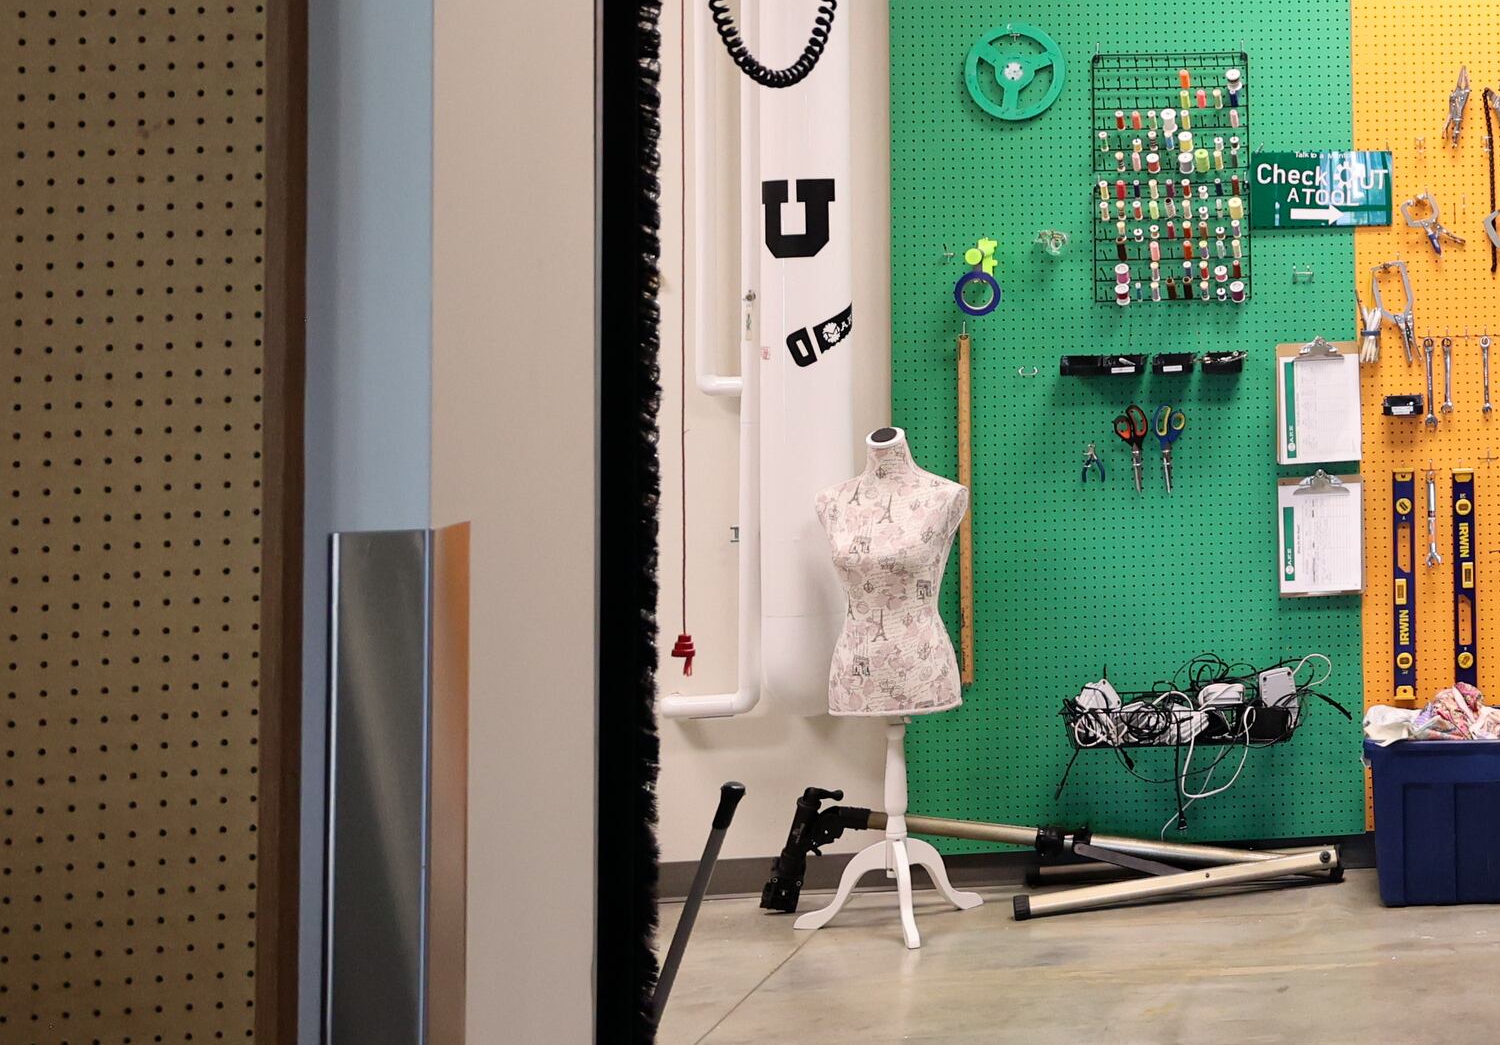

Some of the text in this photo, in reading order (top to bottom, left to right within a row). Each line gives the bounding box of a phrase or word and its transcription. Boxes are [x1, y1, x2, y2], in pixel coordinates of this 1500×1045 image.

[1257, 163, 1328, 186] Check
[1287, 187, 1360, 206] A TOOL
[1458, 522, 1470, 558] IRWIN
[1399, 609, 1410, 646] IRWIN
